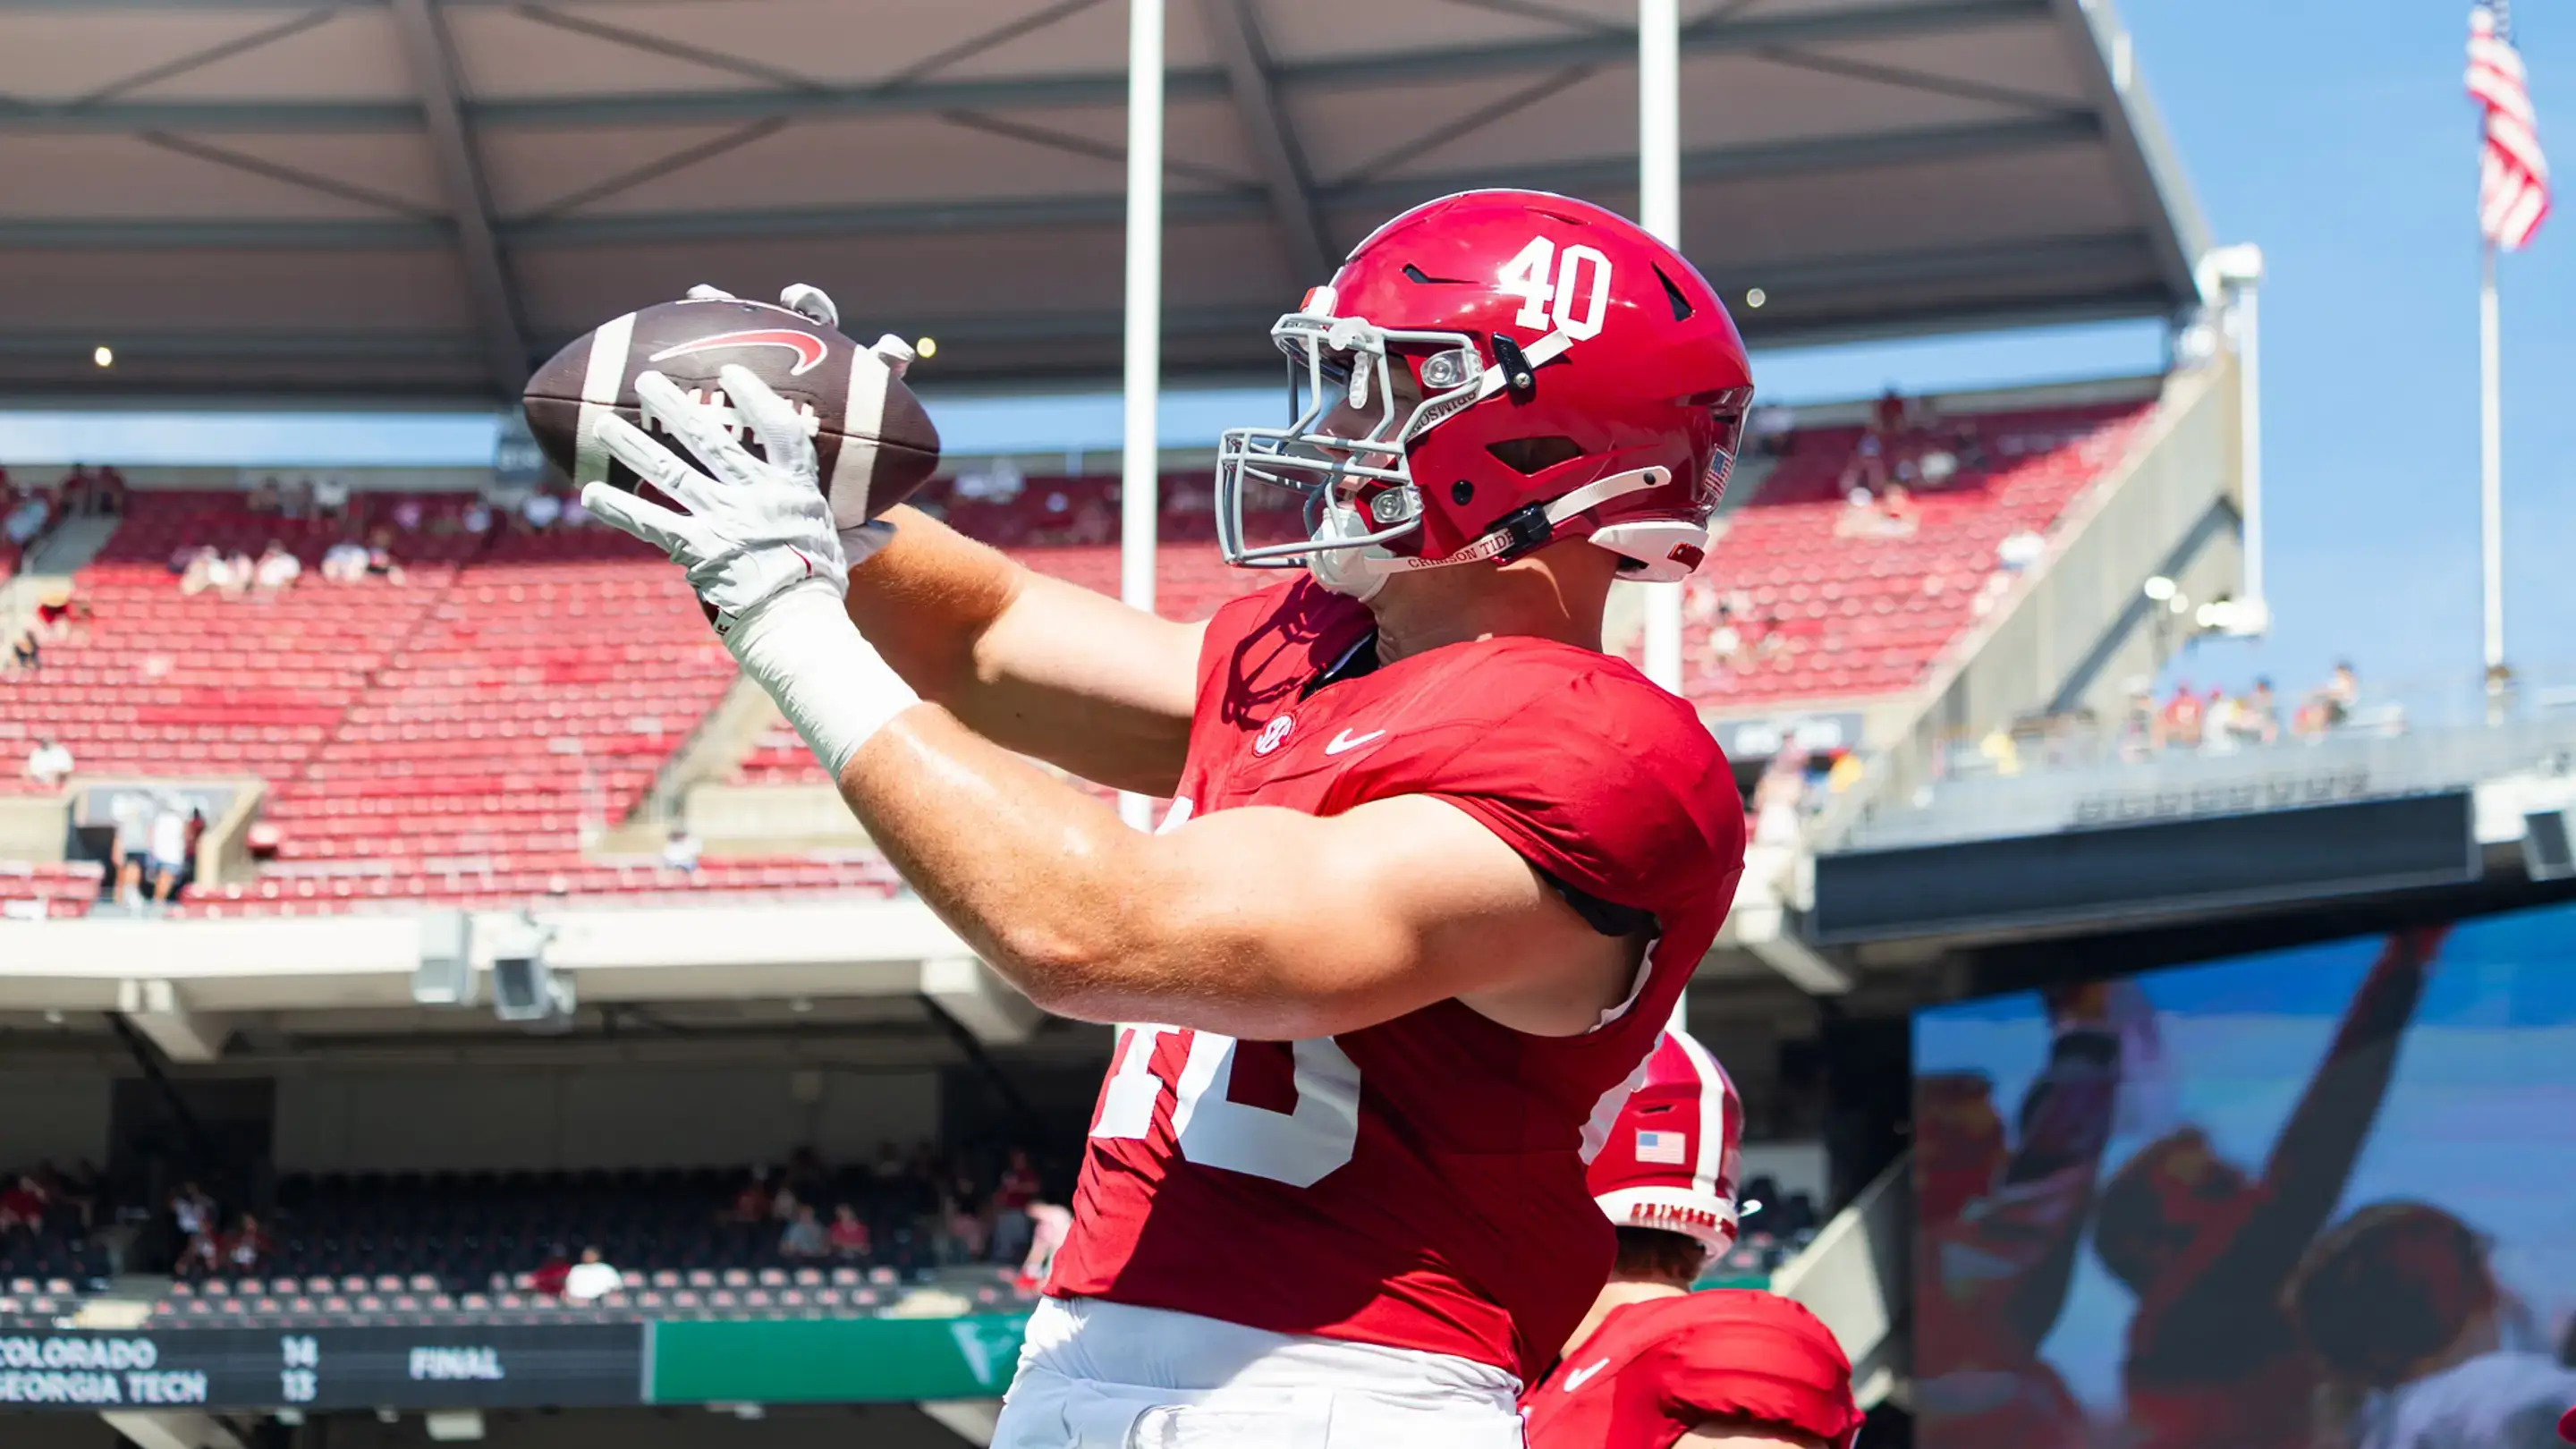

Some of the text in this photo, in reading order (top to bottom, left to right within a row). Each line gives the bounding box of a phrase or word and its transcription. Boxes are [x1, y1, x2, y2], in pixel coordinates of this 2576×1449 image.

[1497, 235, 1613, 342] 40
[0, 1335, 318, 1369] OLORADO 14
[410, 1345, 504, 1380] FINAL
[0, 1368, 318, 1403] EORGIA TECH 13
